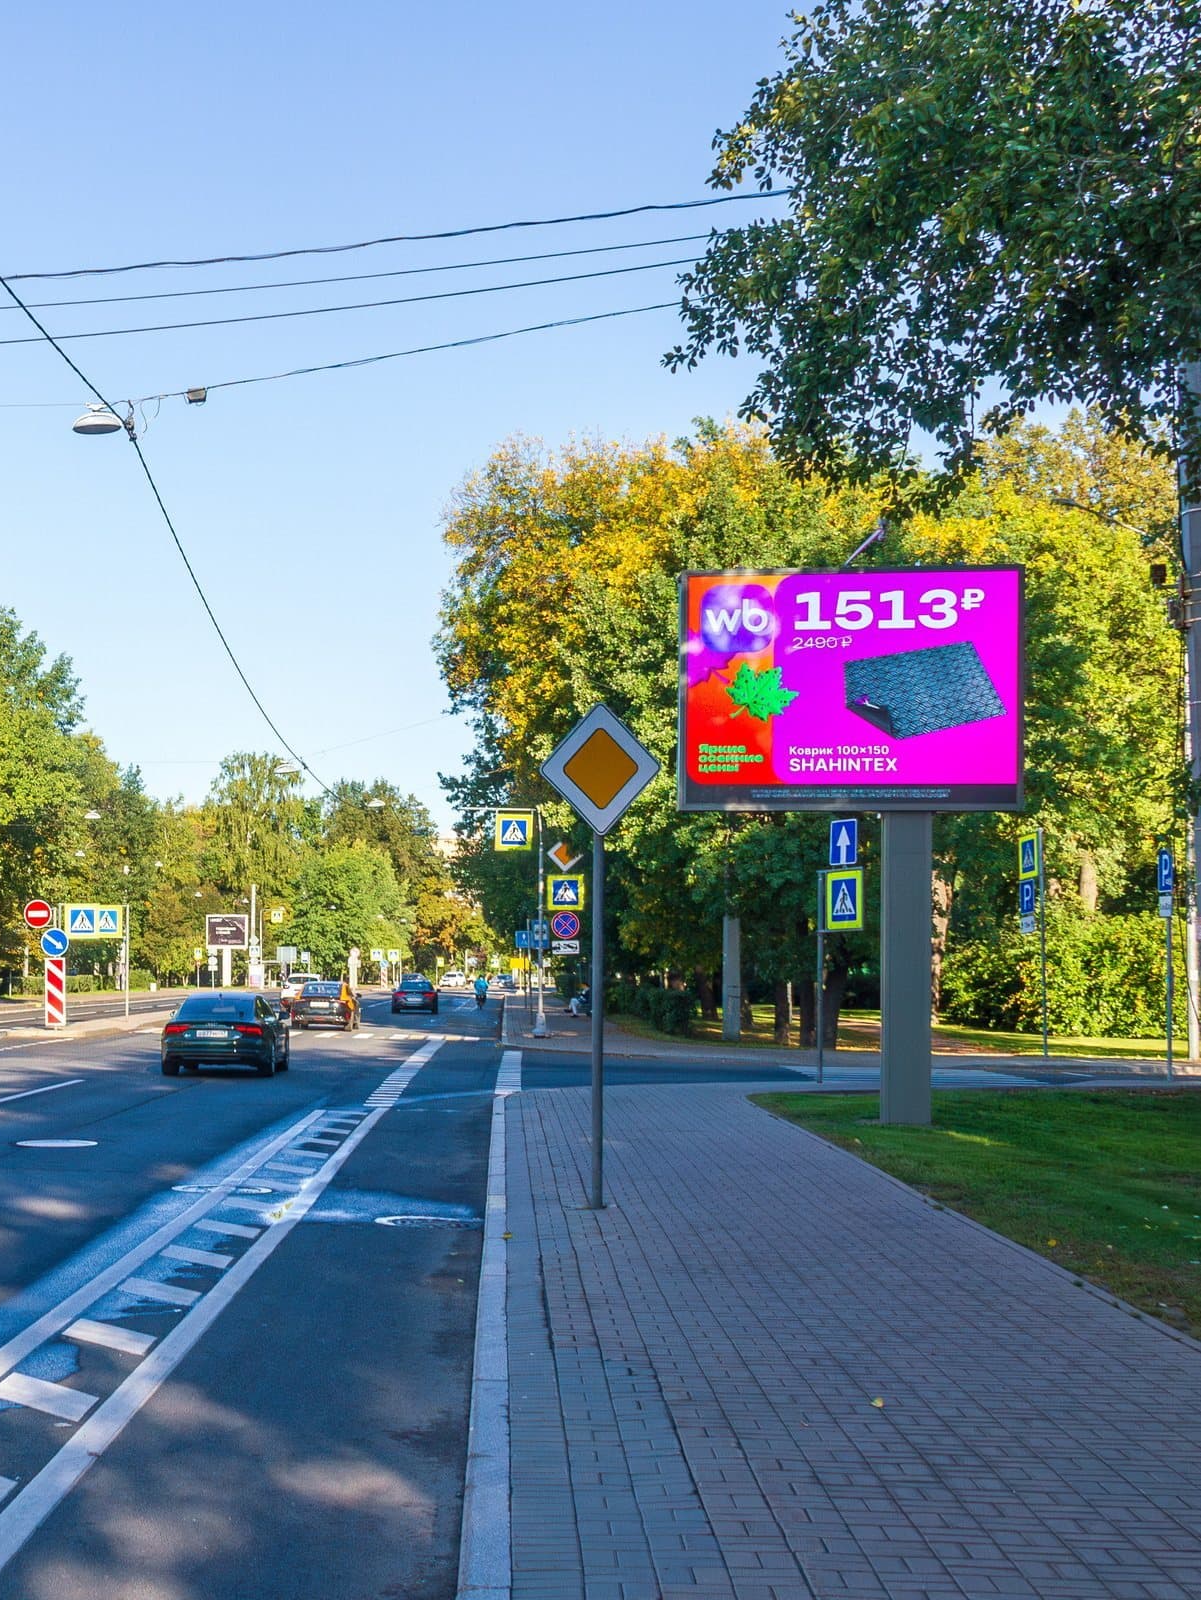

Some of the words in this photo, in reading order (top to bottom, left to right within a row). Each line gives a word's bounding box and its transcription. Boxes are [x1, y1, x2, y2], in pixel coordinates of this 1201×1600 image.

[705, 598, 768, 633] wb
[699, 743, 746, 755] Яркие
[789, 746, 834, 758] Коврик
[698, 754, 764, 763] осенние
[698, 763, 739, 773] цены
[789, 757, 898, 773] SHAHINTEX
